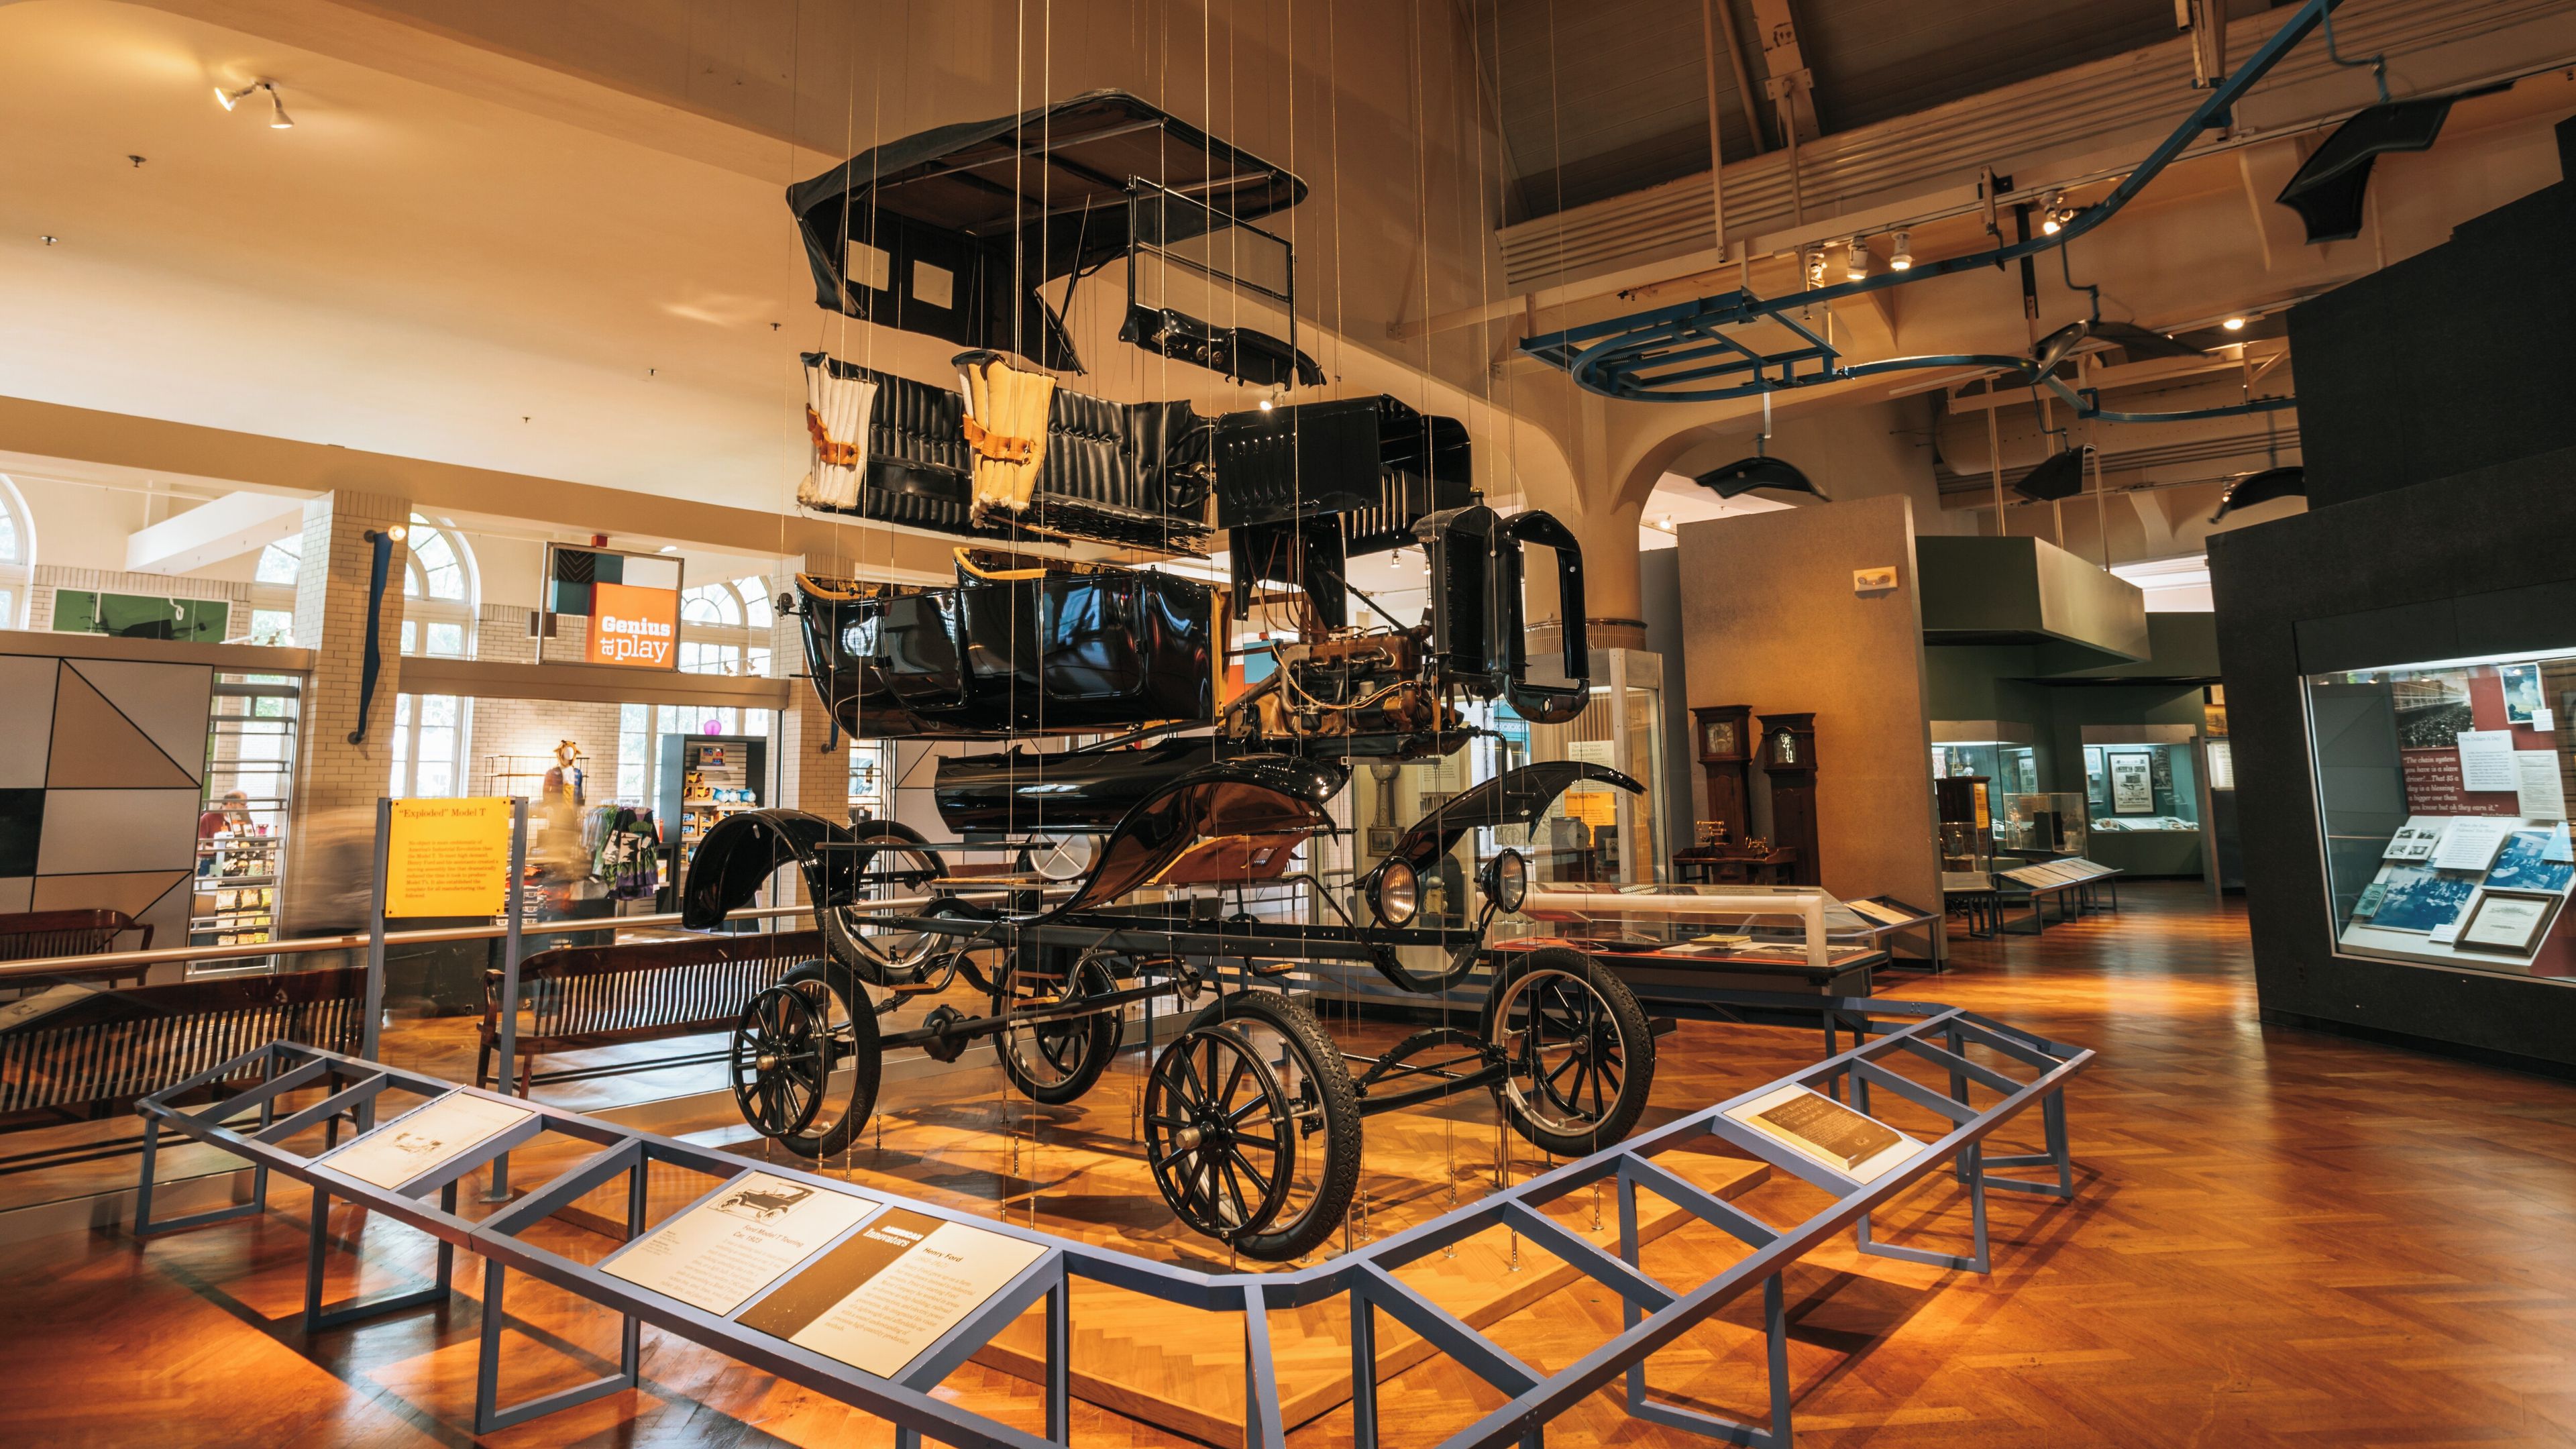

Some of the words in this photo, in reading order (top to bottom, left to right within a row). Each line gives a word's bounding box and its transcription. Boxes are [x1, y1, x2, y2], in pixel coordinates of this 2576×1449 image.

[602, 616, 671, 637] Genius
[600, 637, 614, 655] at
[614, 635, 669, 663] play
[2414, 794, 2431, 802] bigger
[400, 808, 448, 819] “Exploded”
[451, 808, 476, 816] Model
[480, 808, 486, 816] T
[2457, 804, 2471, 812] they
[863, 1228, 910, 1247] Innovators
[923, 1247, 945, 1257] Henry
[945, 1253, 964, 1263] Ford
